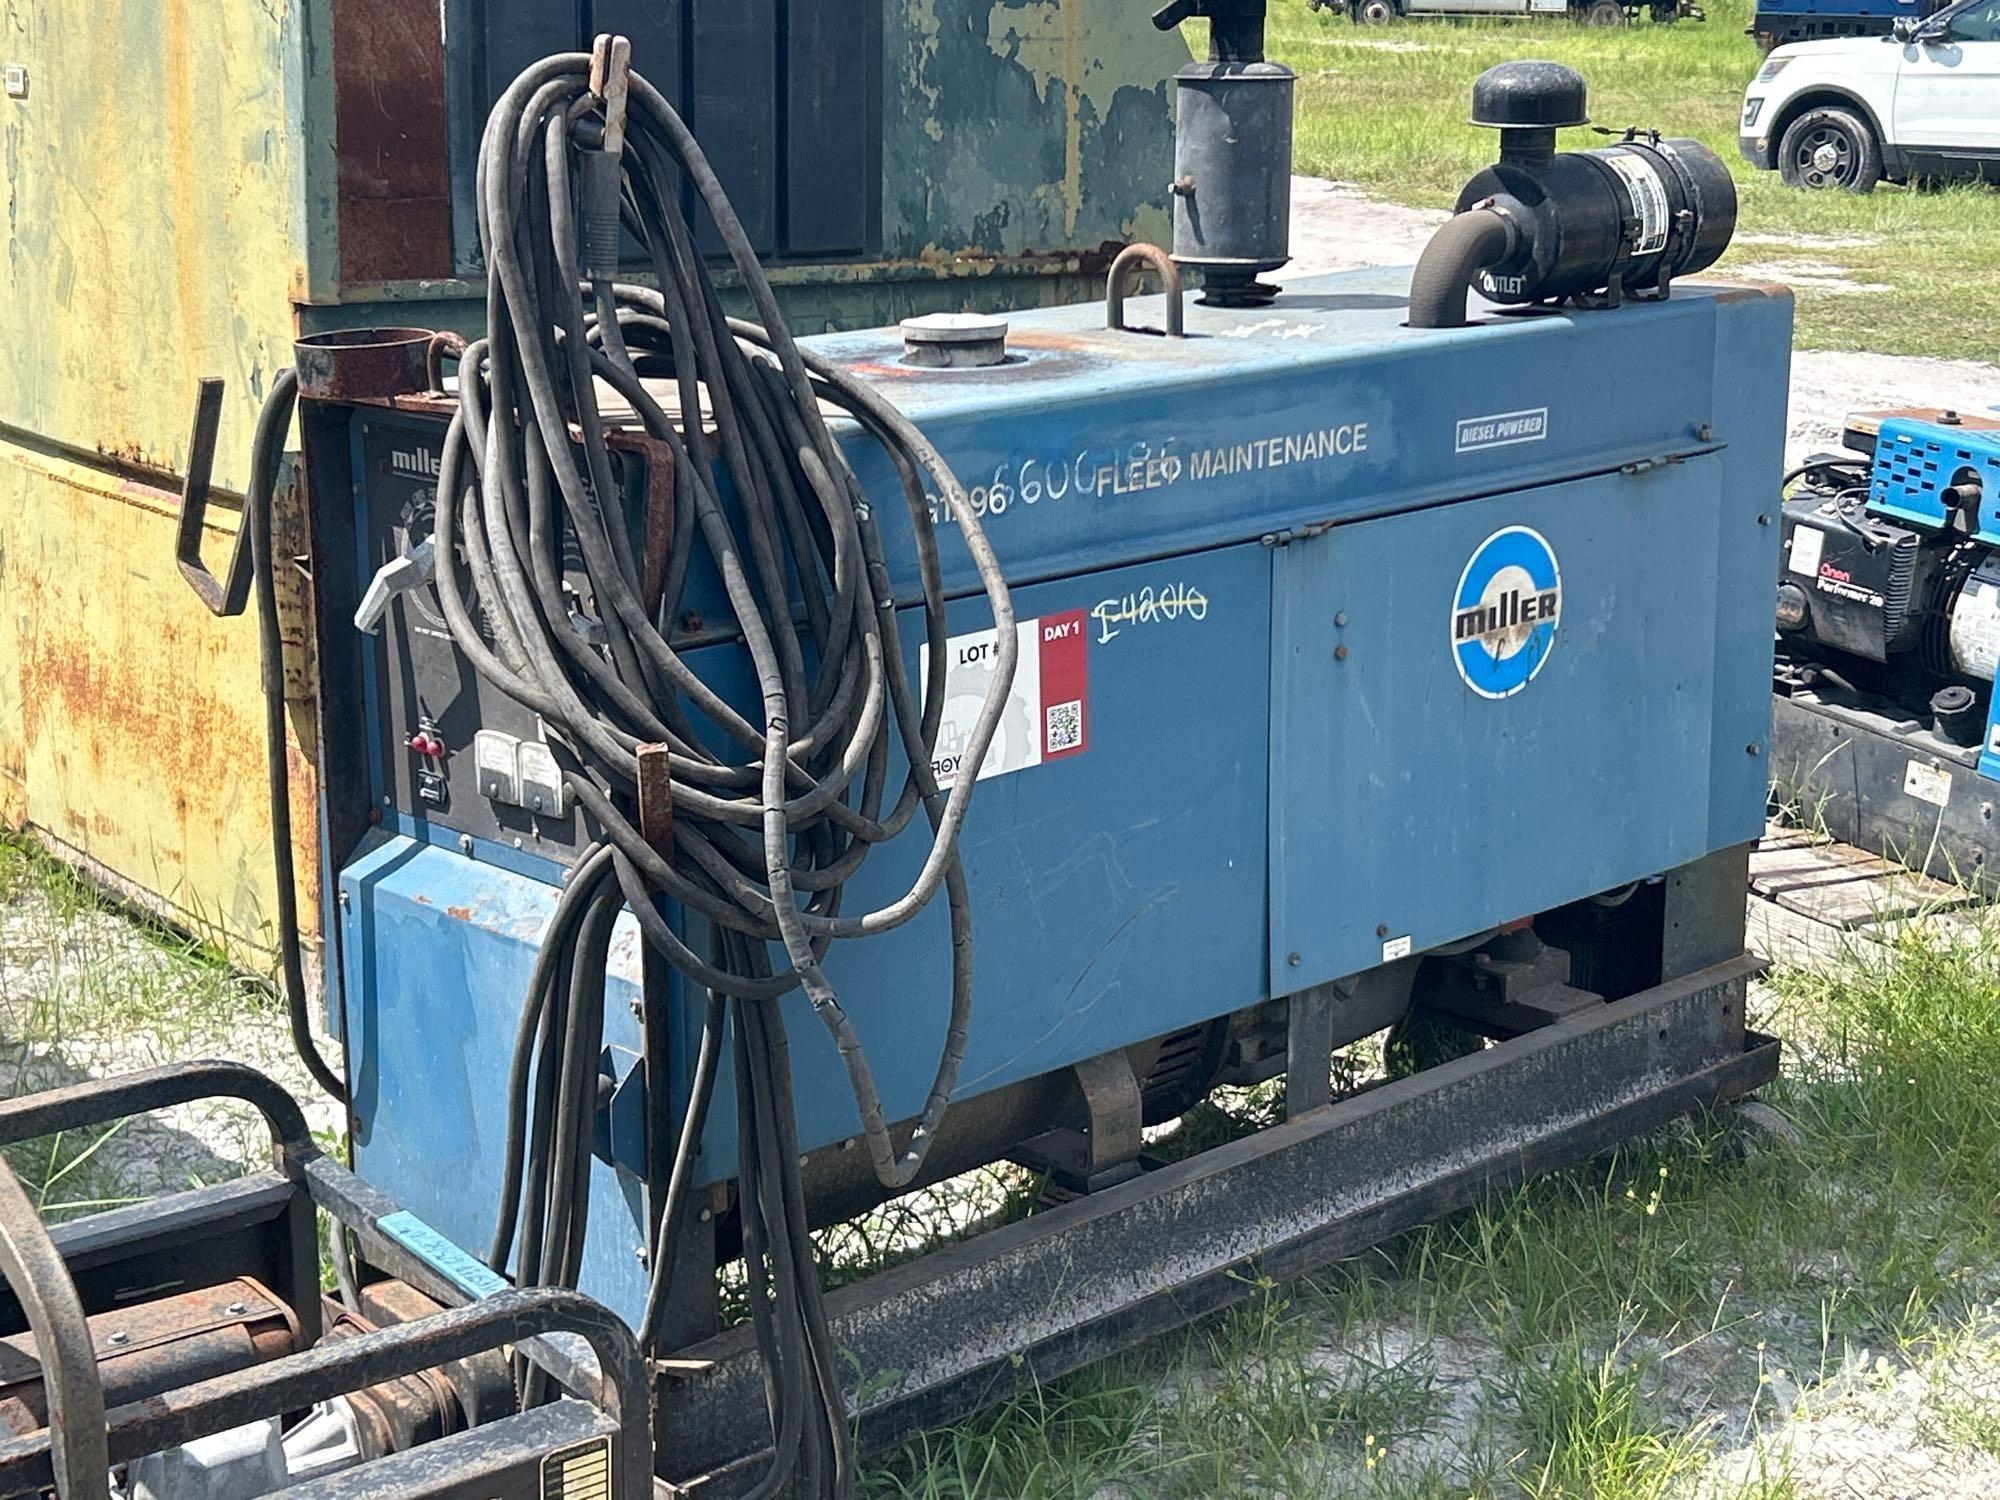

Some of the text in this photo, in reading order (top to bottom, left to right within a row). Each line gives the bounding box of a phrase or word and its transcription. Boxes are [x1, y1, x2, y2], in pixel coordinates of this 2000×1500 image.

[1461, 417, 1543, 444] DIESEL POWERED
[1095, 455, 1180, 498] FLEET
[1190, 422, 1369, 481] MAINTENANCE
[1044, 620, 1080, 642] DAY 1
[960, 643, 989, 665] LOT
